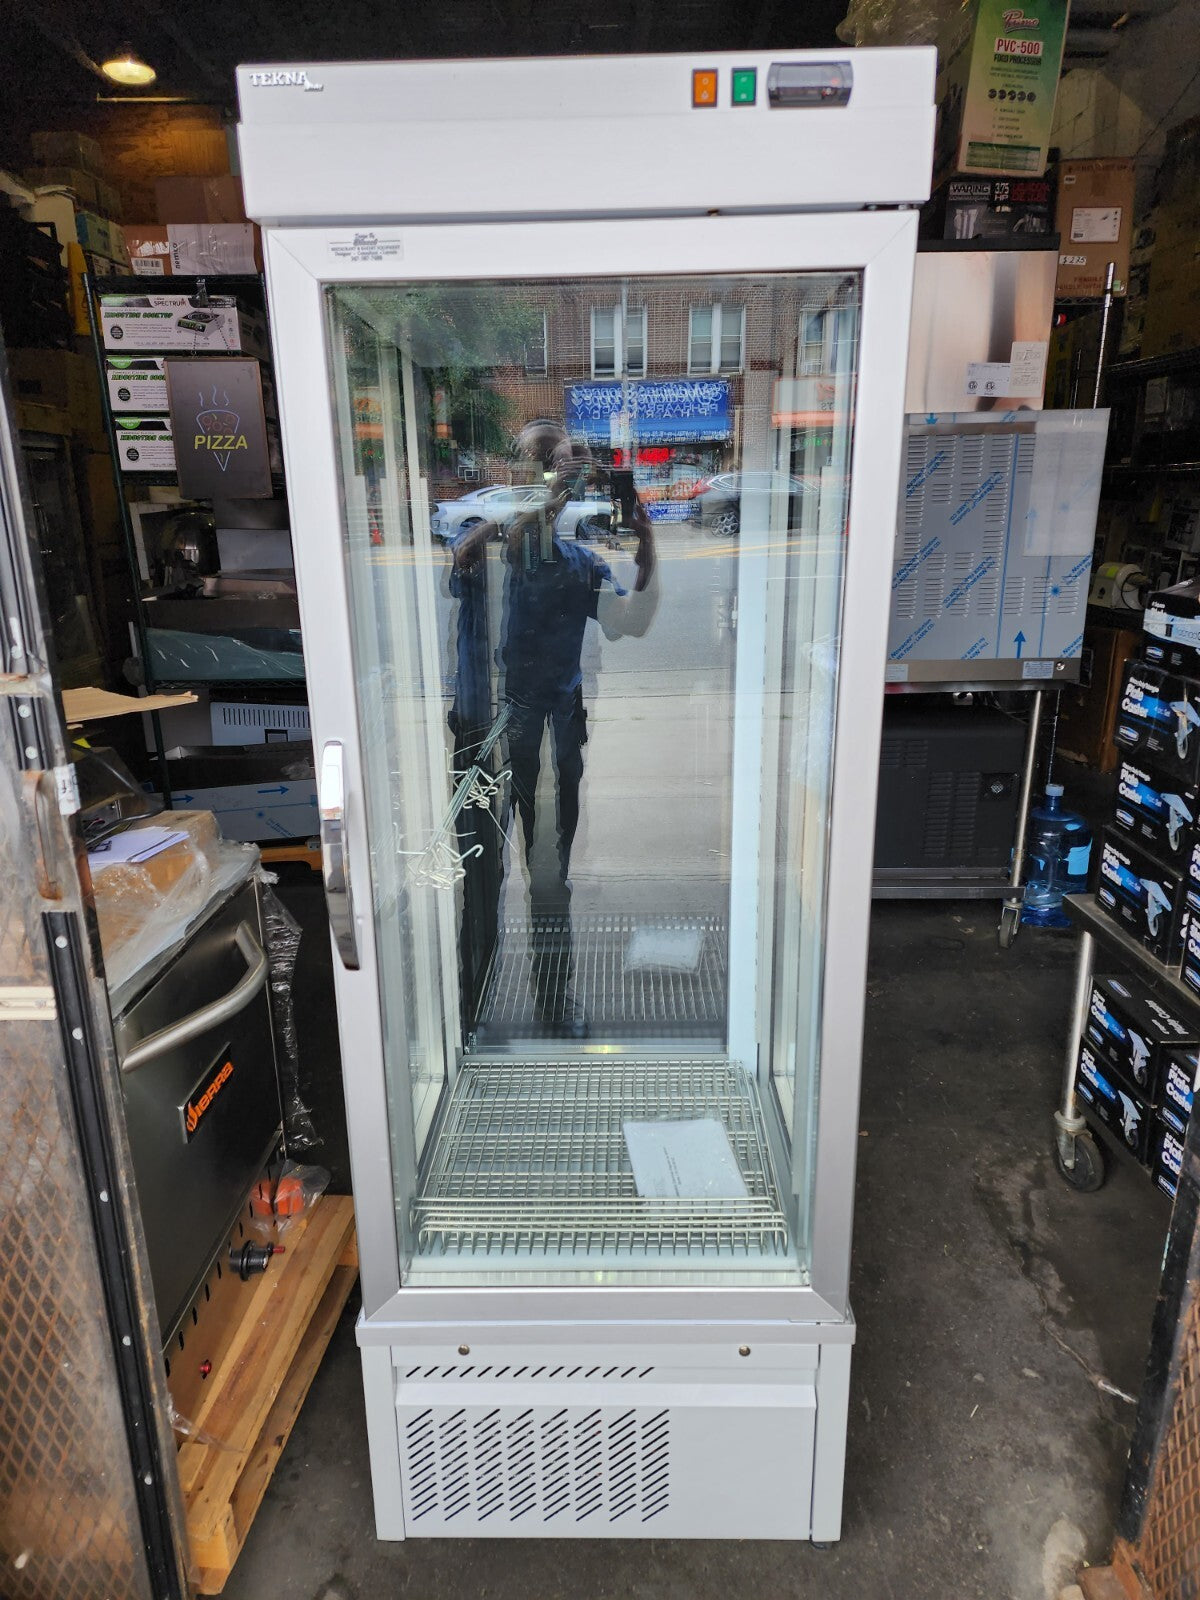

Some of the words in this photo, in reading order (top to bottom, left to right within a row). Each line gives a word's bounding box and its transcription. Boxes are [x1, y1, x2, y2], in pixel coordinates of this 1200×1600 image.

[997, 39, 1040, 54] PVC-500
[250, 72, 307, 86] TEKNA
[951, 184, 990, 195] WARING
[194, 435, 248, 450] PIZZA
[1125, 683, 1144, 701] Plate
[1121, 698, 1148, 718] Caster
[1121, 768, 1139, 787] Plate
[1119, 782, 1142, 804] Caster
[1102, 862, 1122, 886] Caster
[1168, 1068, 1190, 1095] Plate
[1163, 1138, 1183, 1163] Plat
